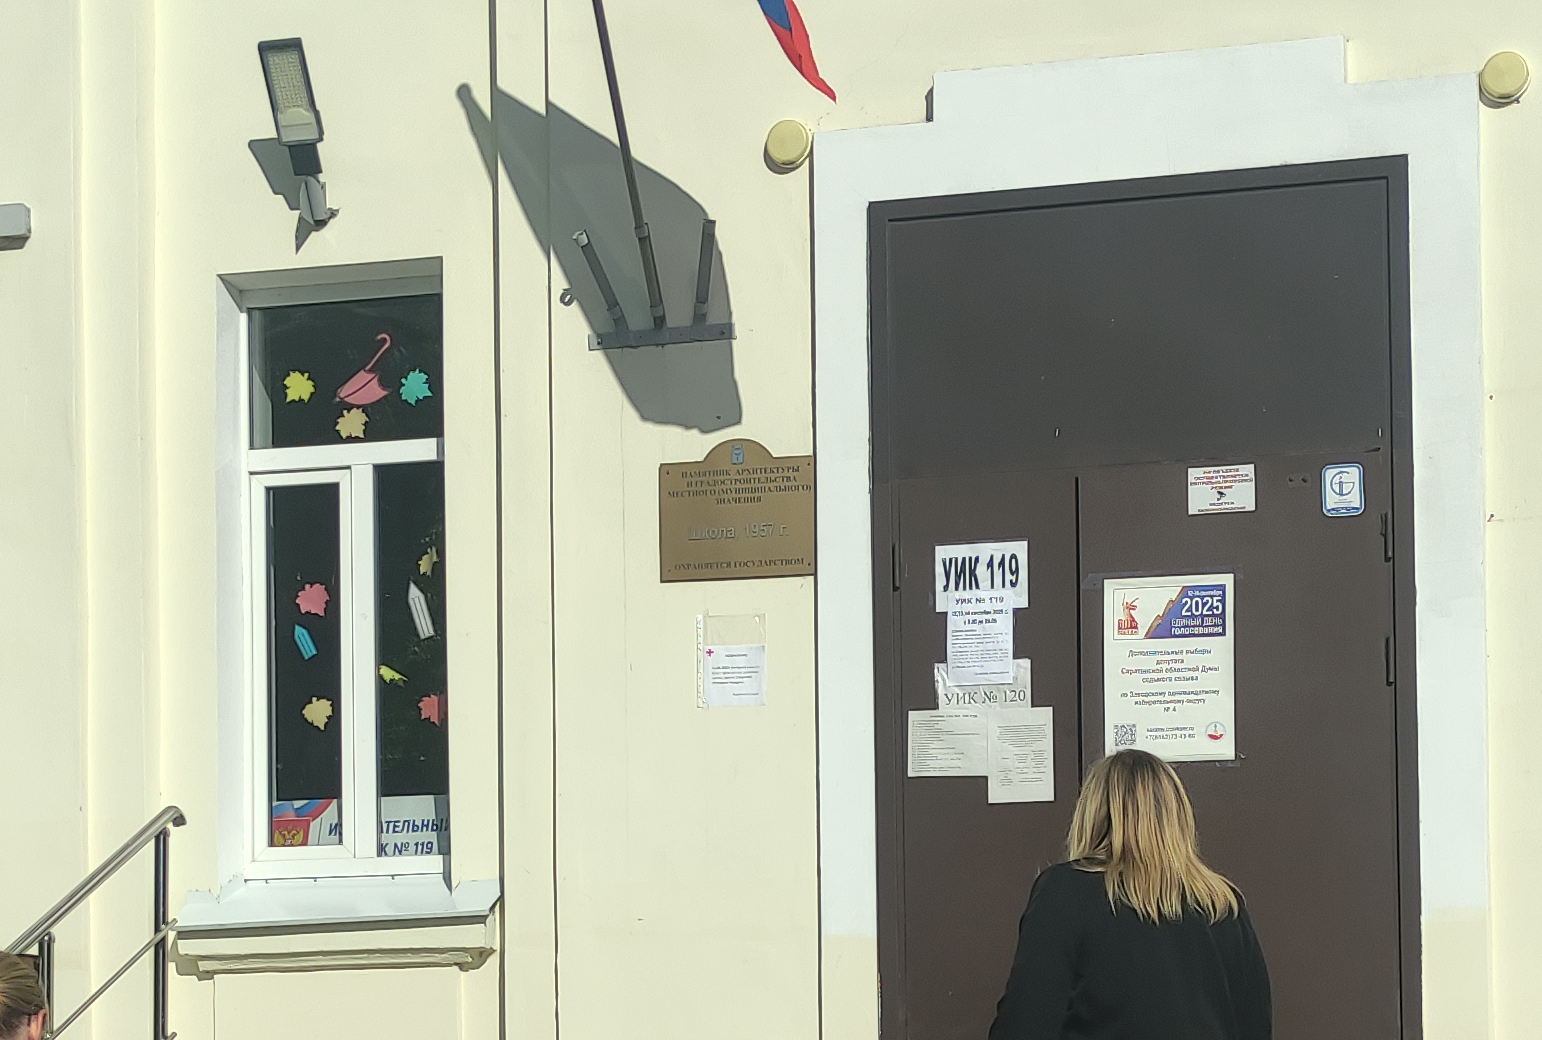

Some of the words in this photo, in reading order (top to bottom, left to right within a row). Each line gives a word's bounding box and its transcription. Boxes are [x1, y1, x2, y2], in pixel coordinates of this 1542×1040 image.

[681, 469, 731, 479] ПАМЯТНИК
[735, 466, 800, 477] АРХИТЕКТУРЫ
[695, 476, 797, 488] ГРАДОСТРОИТЕЛЬСТВА
[668, 489, 716, 498] МЕСТНОГО
[717, 485, 811, 496] (МУНИЦИПАЛЬНОГО)
[715, 496, 762, 505] ЗНАЧЕНИЯ
[744, 523, 774, 538] 1957
[674, 561, 732, 571] ОХРАНЯЕТСЯ
[734, 558, 804, 569] ГОСУДАРСТВОМ
[941, 555, 980, 592] УИК
[987, 553, 1019, 589] 119
[1181, 597, 1222, 616] 2025
[1203, 617, 1223, 626] ДЕНЬ
[1171, 626, 1222, 635] ГОЛОСОВАНИЯ
[944, 691, 979, 707] УИК
[982, 690, 998, 704] №
[1003, 688, 1026, 704] 120
[393, 842, 410, 855] №
[414, 841, 434, 855] 119
